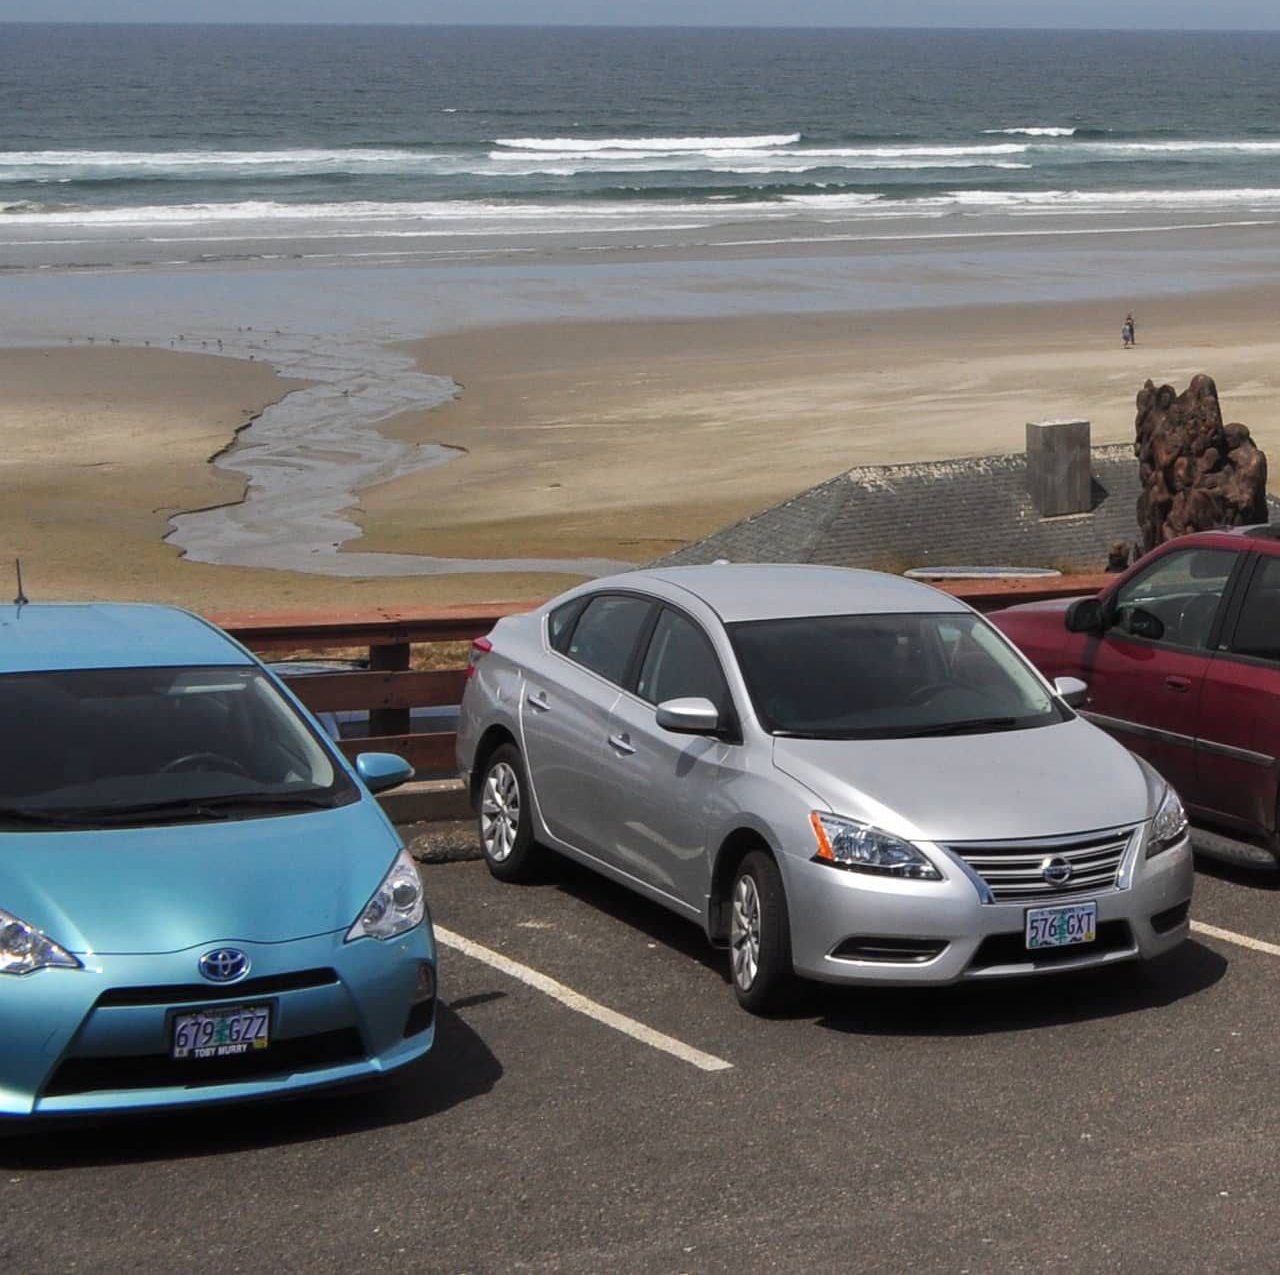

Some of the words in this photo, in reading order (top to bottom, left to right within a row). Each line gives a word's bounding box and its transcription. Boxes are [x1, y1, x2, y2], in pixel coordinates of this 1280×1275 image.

[1030, 916, 1057, 940] 576
[1067, 912, 1094, 935] GXT
[176, 1019, 214, 1048] 679
[229, 1014, 267, 1042] GZZ
